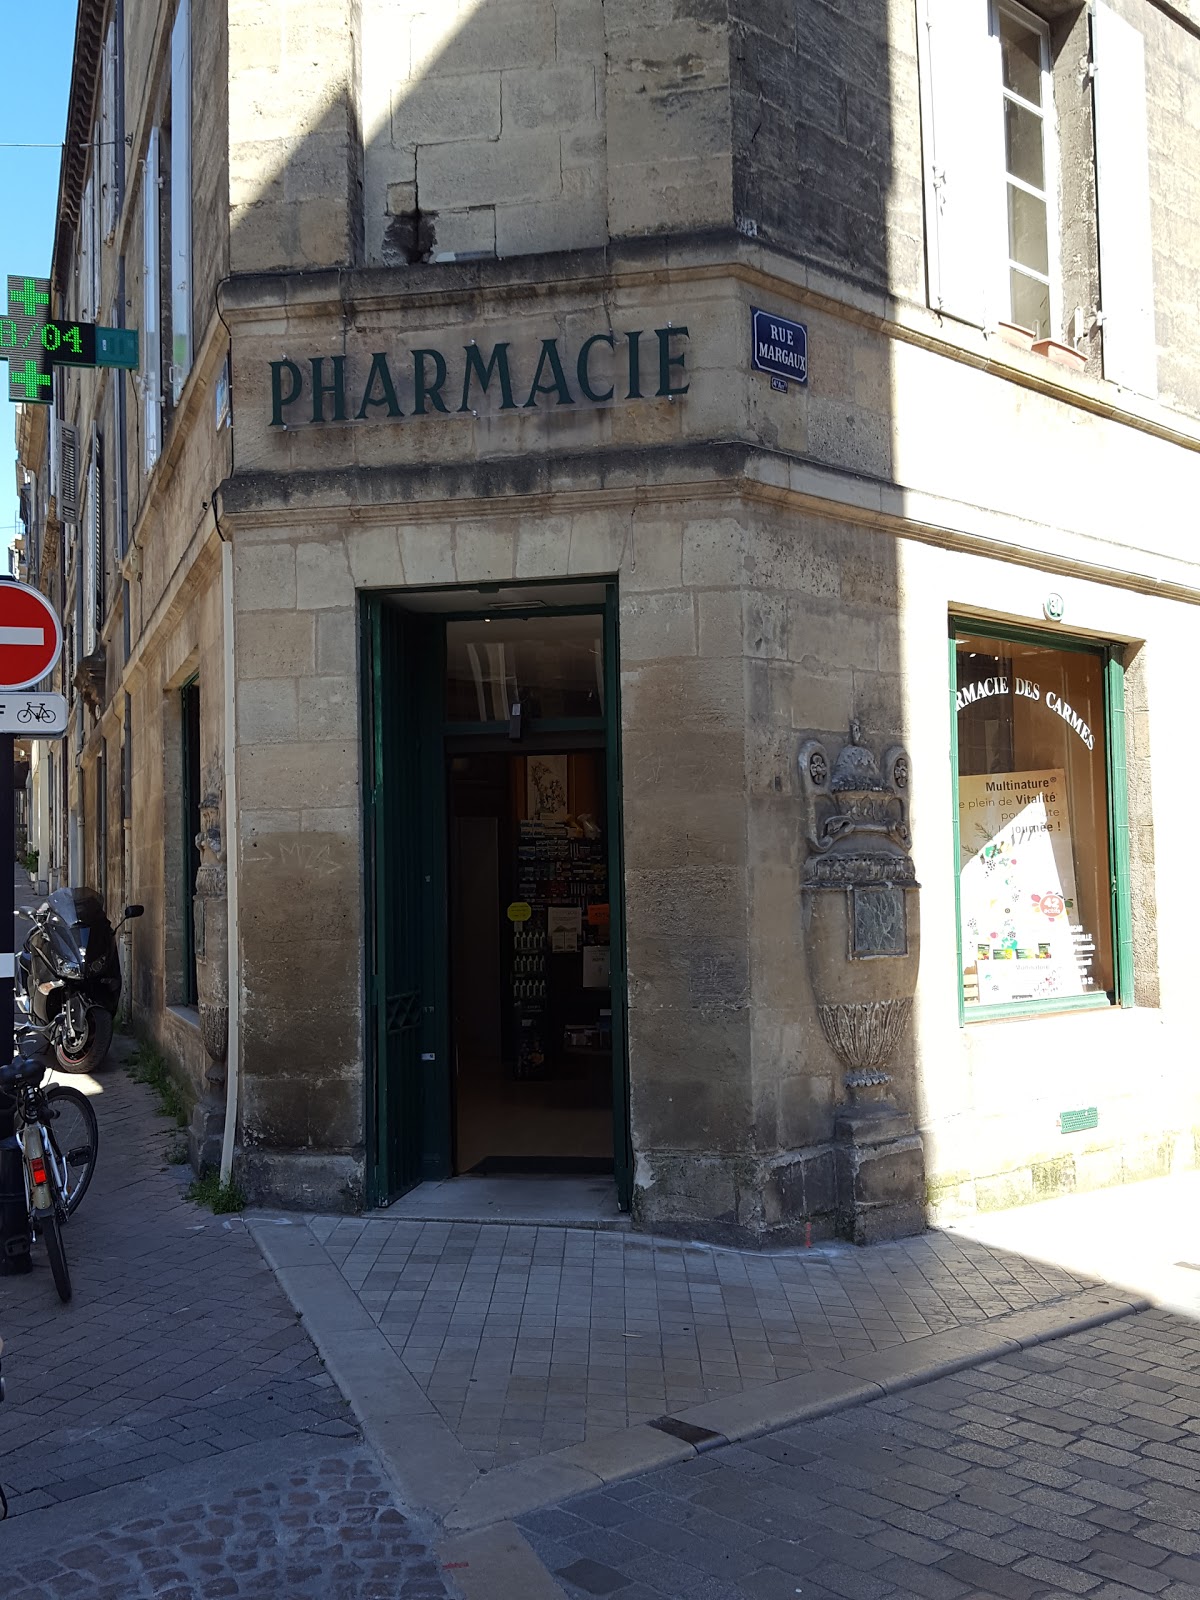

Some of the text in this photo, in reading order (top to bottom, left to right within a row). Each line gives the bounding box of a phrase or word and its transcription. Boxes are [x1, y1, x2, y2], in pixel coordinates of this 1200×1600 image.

[770, 324, 794, 346] RUE
[759, 342, 806, 371] MARGAUX
[268, 326, 691, 426] PHARMACIE
[955, 676, 1096, 751] RMACIE DES CARMES
[969, 798, 995, 810] plein
[998, 797, 1013, 806] de
[1016, 792, 1056, 805] Vitalité
[1044, 897, 1060, 908] 42
